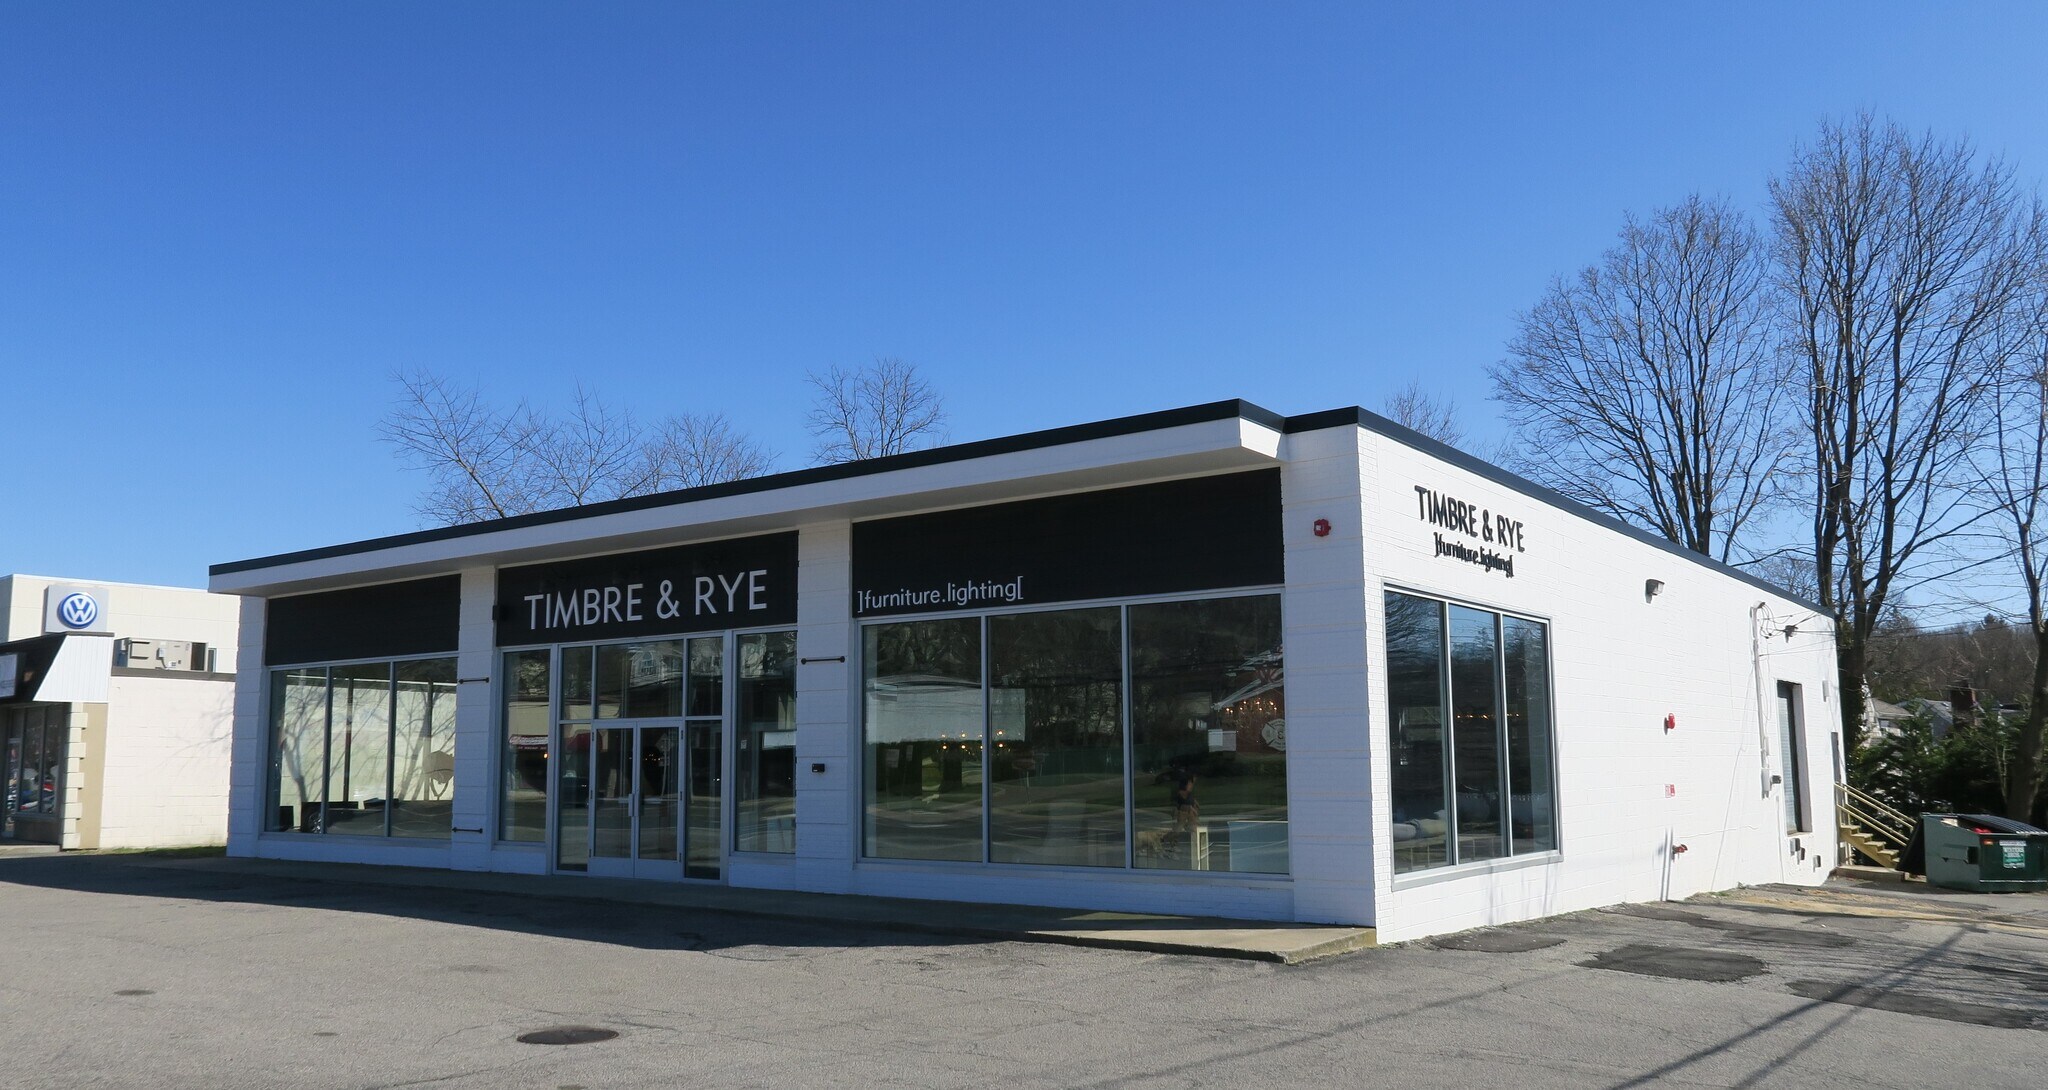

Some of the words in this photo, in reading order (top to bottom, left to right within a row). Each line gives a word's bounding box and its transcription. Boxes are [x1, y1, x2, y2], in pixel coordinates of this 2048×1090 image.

[1414, 485, 1478, 538] TIMBRE
[1482, 509, 1494, 543] &
[1497, 514, 1525, 553] RYE
[61, 593, 97, 628] VW
[524, 583, 643, 630] TIMBRE
[656, 579, 680, 620] &
[695, 569, 768, 616] RYE
